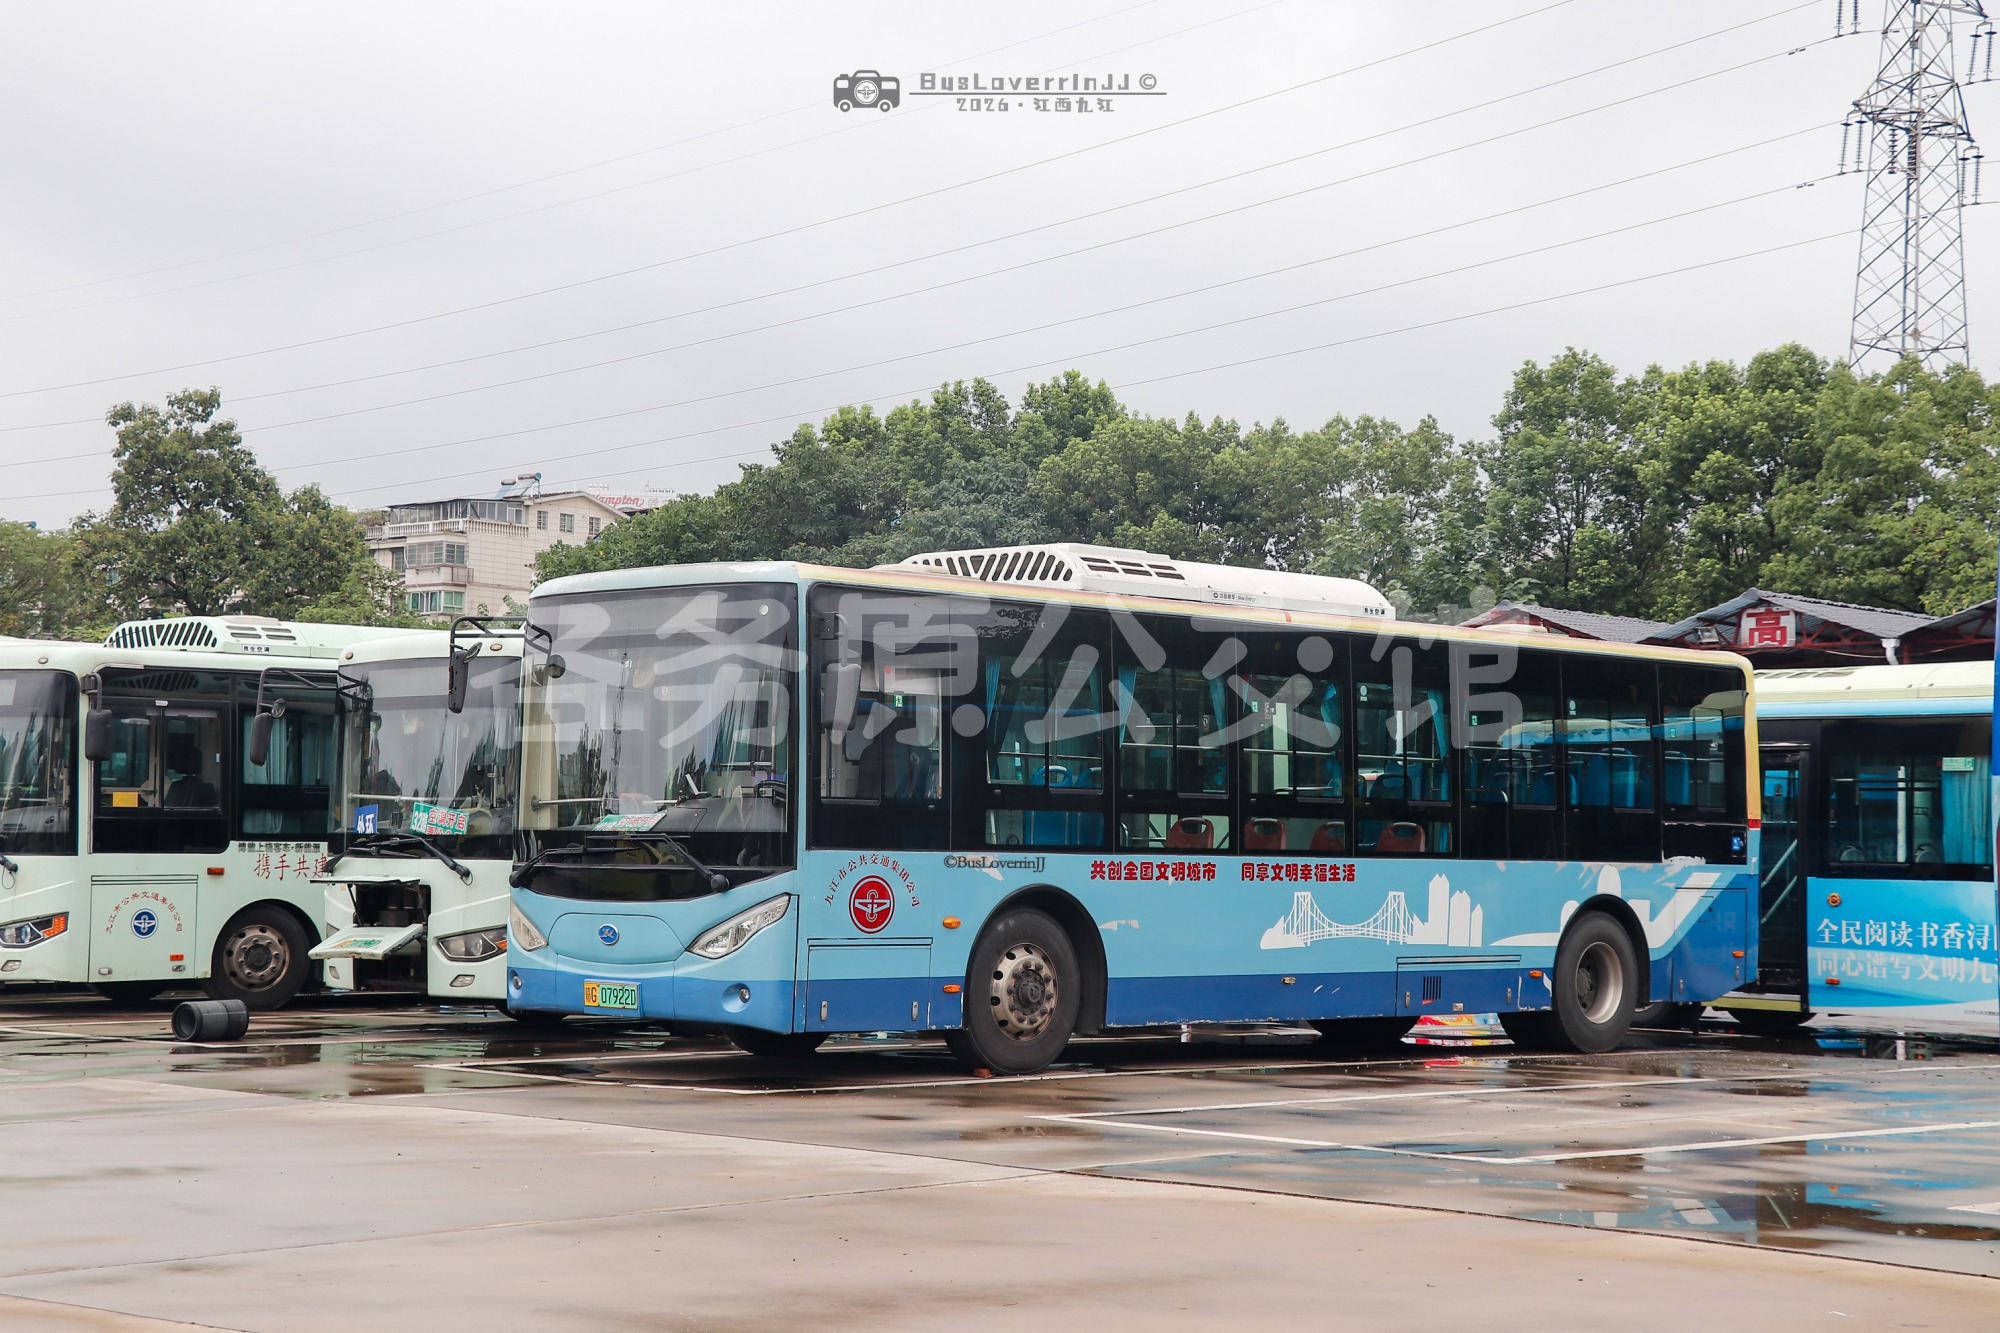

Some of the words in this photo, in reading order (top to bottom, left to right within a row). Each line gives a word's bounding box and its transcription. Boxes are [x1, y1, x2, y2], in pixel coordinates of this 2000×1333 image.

[1746, 608, 1790, 646] 高
[824, 853, 921, 907] 九江市公共交通集团公司
[1090, 860, 1217, 882] 共创全国文明城市
[1240, 862, 1357, 883] 同享文明幸福生活
[1815, 917, 1998, 952] 全民阅读书香浔
[1815, 950, 1998, 984] 同心谱写文明九
